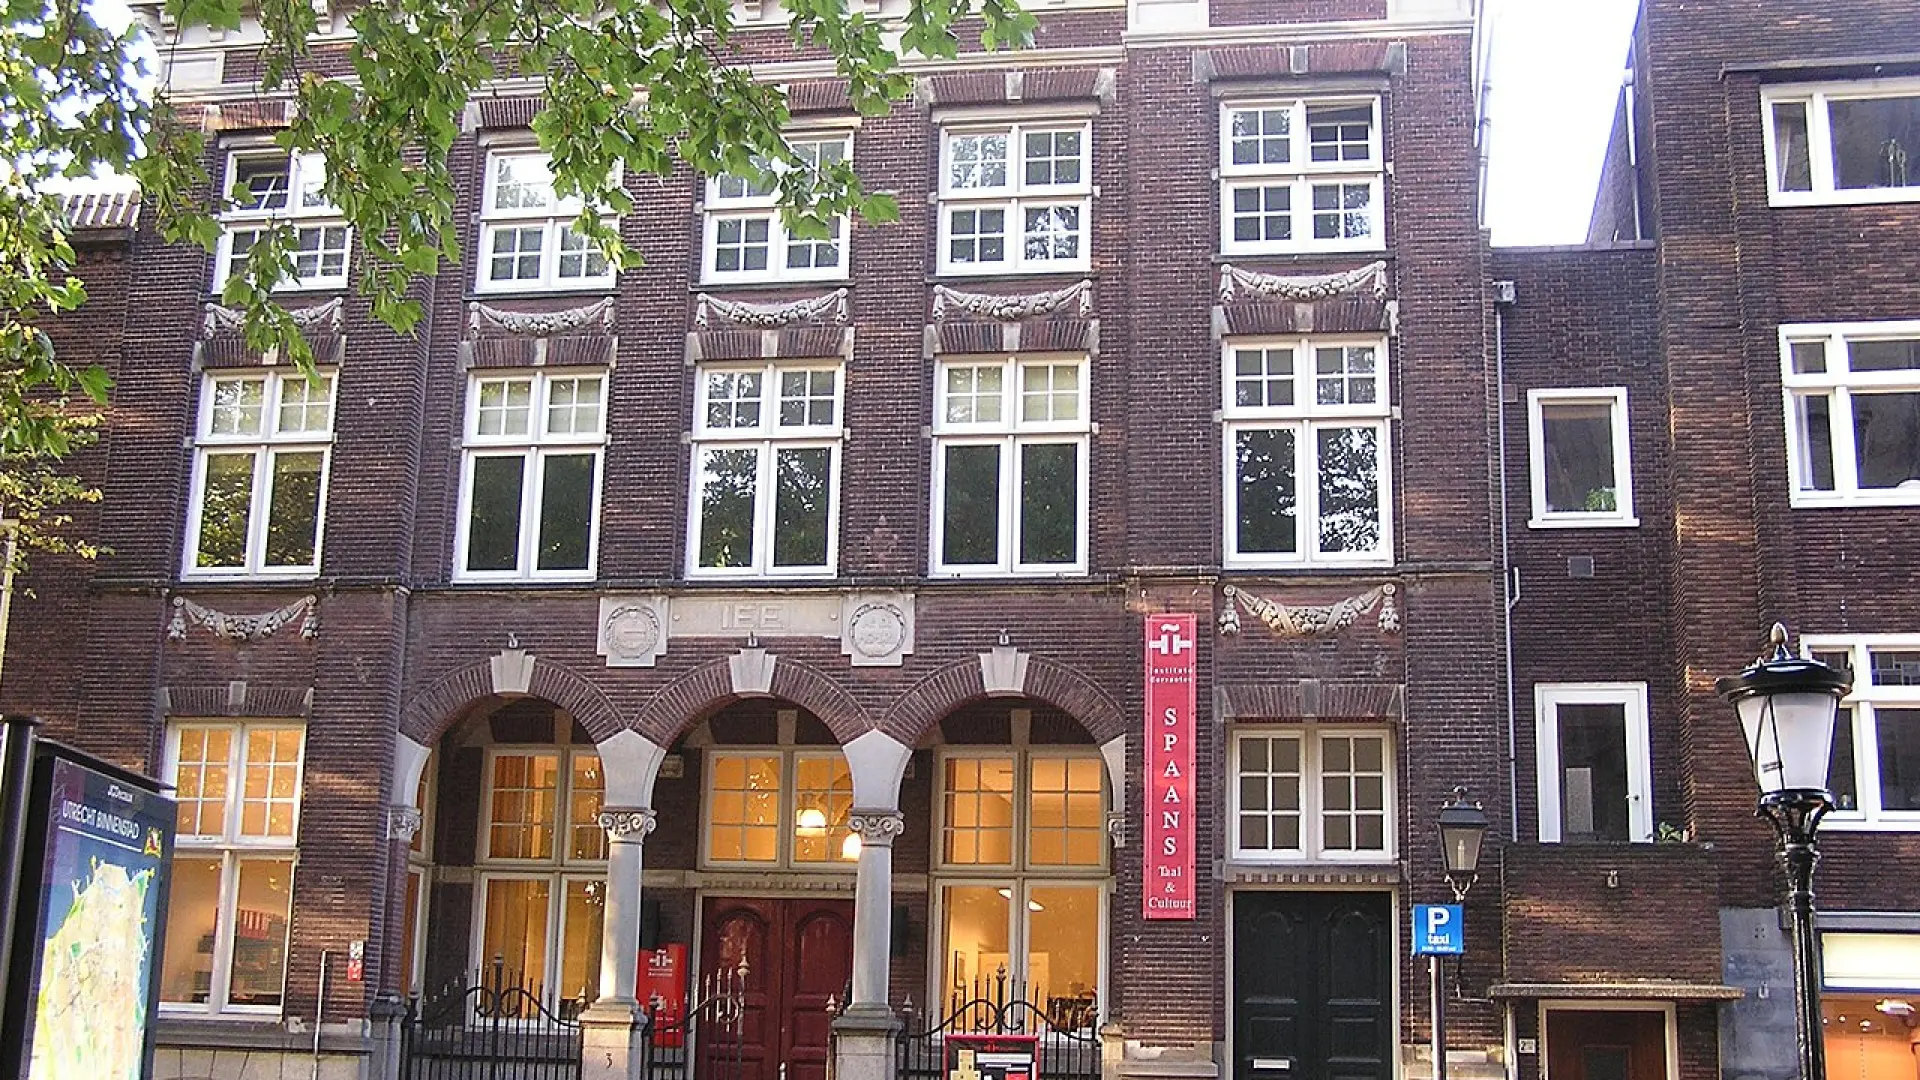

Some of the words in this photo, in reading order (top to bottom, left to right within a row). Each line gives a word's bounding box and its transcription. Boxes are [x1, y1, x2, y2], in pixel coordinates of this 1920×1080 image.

[1162, 707, 1181, 856] SPAANS
[62, 800, 96, 825] UTRECHT
[96, 811, 139, 839] BINNENSTAD
[1157, 865, 1182, 877] Taal
[1164, 881, 1176, 893] &
[1148, 896, 1192, 909] Cultuur
[1427, 907, 1450, 934] P
[1427, 933, 1450, 945] taxi
